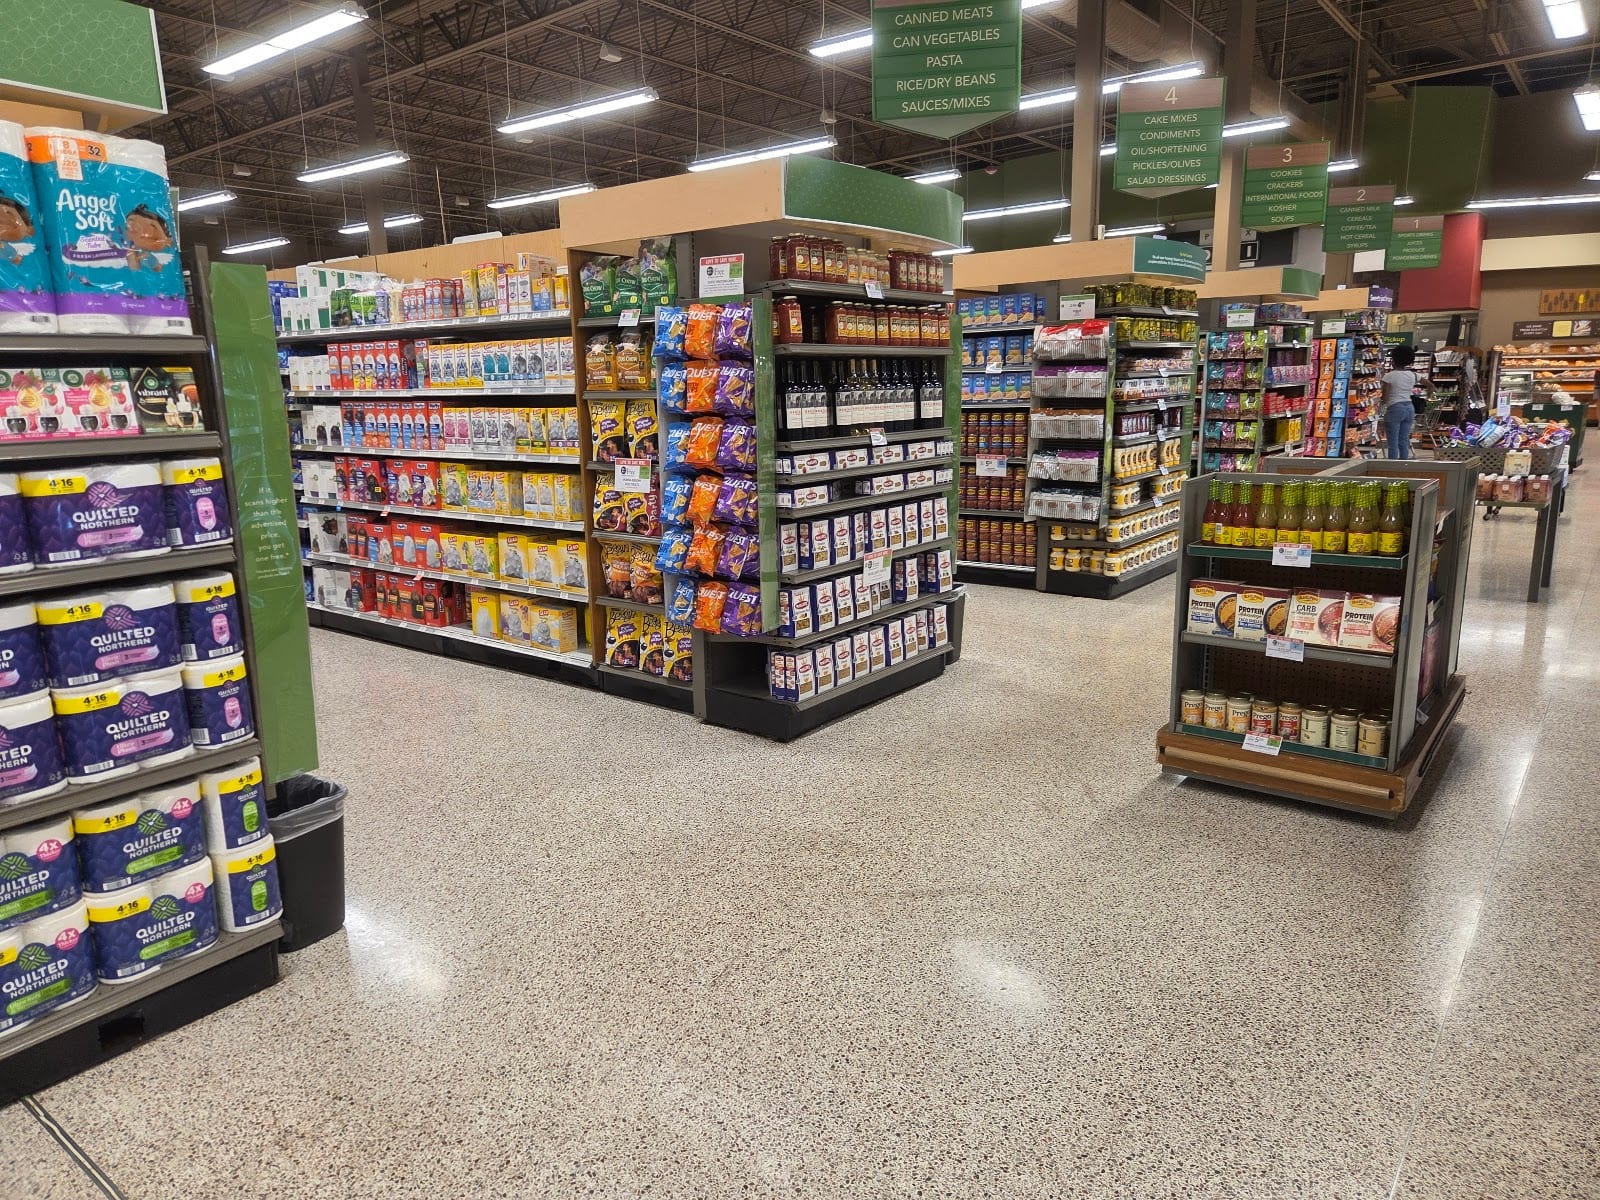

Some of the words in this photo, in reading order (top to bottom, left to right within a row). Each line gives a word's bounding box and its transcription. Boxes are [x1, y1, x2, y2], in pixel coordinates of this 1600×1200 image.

[895, 11, 948, 25] CANNED
[952, 6, 993, 21] MEATS
[893, 35, 920, 48] CAN
[924, 28, 1000, 46] VEGETABLES
[926, 54, 963, 68] PASTA
[896, 76, 952, 92] RICE/DRY
[955, 73, 996, 87] BEANS
[1164, 86, 1178, 105] 4
[902, 96, 990, 113] SAUCES/MIXES
[1144, 115, 1169, 125] CAKE
[1170, 114, 1197, 123] MIXES
[1139, 129, 1200, 141] CONDIMENTS
[88, 145, 101, 156] 32
[1131, 143, 1207, 156] OIL/SHORTENING
[1281, 147, 1293, 163] 3
[1132, 159, 1201, 170] PICKLES/OLIVES
[1127, 175, 1156, 185] SALAD
[1157, 173, 1206, 184] DRESSINGS
[1270, 169, 1302, 178] COOKIES
[1266, 181, 1304, 190] CRACKERS
[1245, 192, 1298, 202] INTERNATIONAL
[1299, 190, 1323, 200] FOODS
[1357, 189, 1366, 201] 2
[56, 189, 117, 216] Angel
[1268, 204, 1296, 212] KOSHER
[75, 210, 115, 232] Soft
[1271, 215, 1295, 223] SOUPS
[1414, 219, 1419, 228] 1
[687, 367, 719, 378] QUEST
[72, 505, 139, 523] QUILTED
[80, 518, 135, 530] NORTHERN
[251, 520, 287, 528] advertised
[728, 588, 757, 604] QUEST
[205, 603, 228, 612] QUILTED
[1191, 599, 1215, 608] PROTEIN
[1296, 605, 1316, 613] CARB
[1238, 606, 1265, 615] PROTEIN
[1345, 612, 1375, 621] PROTEIN
[90, 626, 156, 647] QUILTED
[98, 637, 152, 654] NORTHERN
[217, 686, 240, 695] QUILTED
[105, 710, 170, 734] QUILTED
[1279, 714, 1298, 722] Prego
[114, 722, 166, 741] NORTHERN
[122, 827, 183, 853] QUILTED
[129, 838, 177, 859] NORTHERN
[135, 911, 196, 939] QUILTED
[142, 922, 192, 944] NORTHERN
[2, 959, 69, 992] QUILTED
[10, 971, 65, 998] NORTHERN
